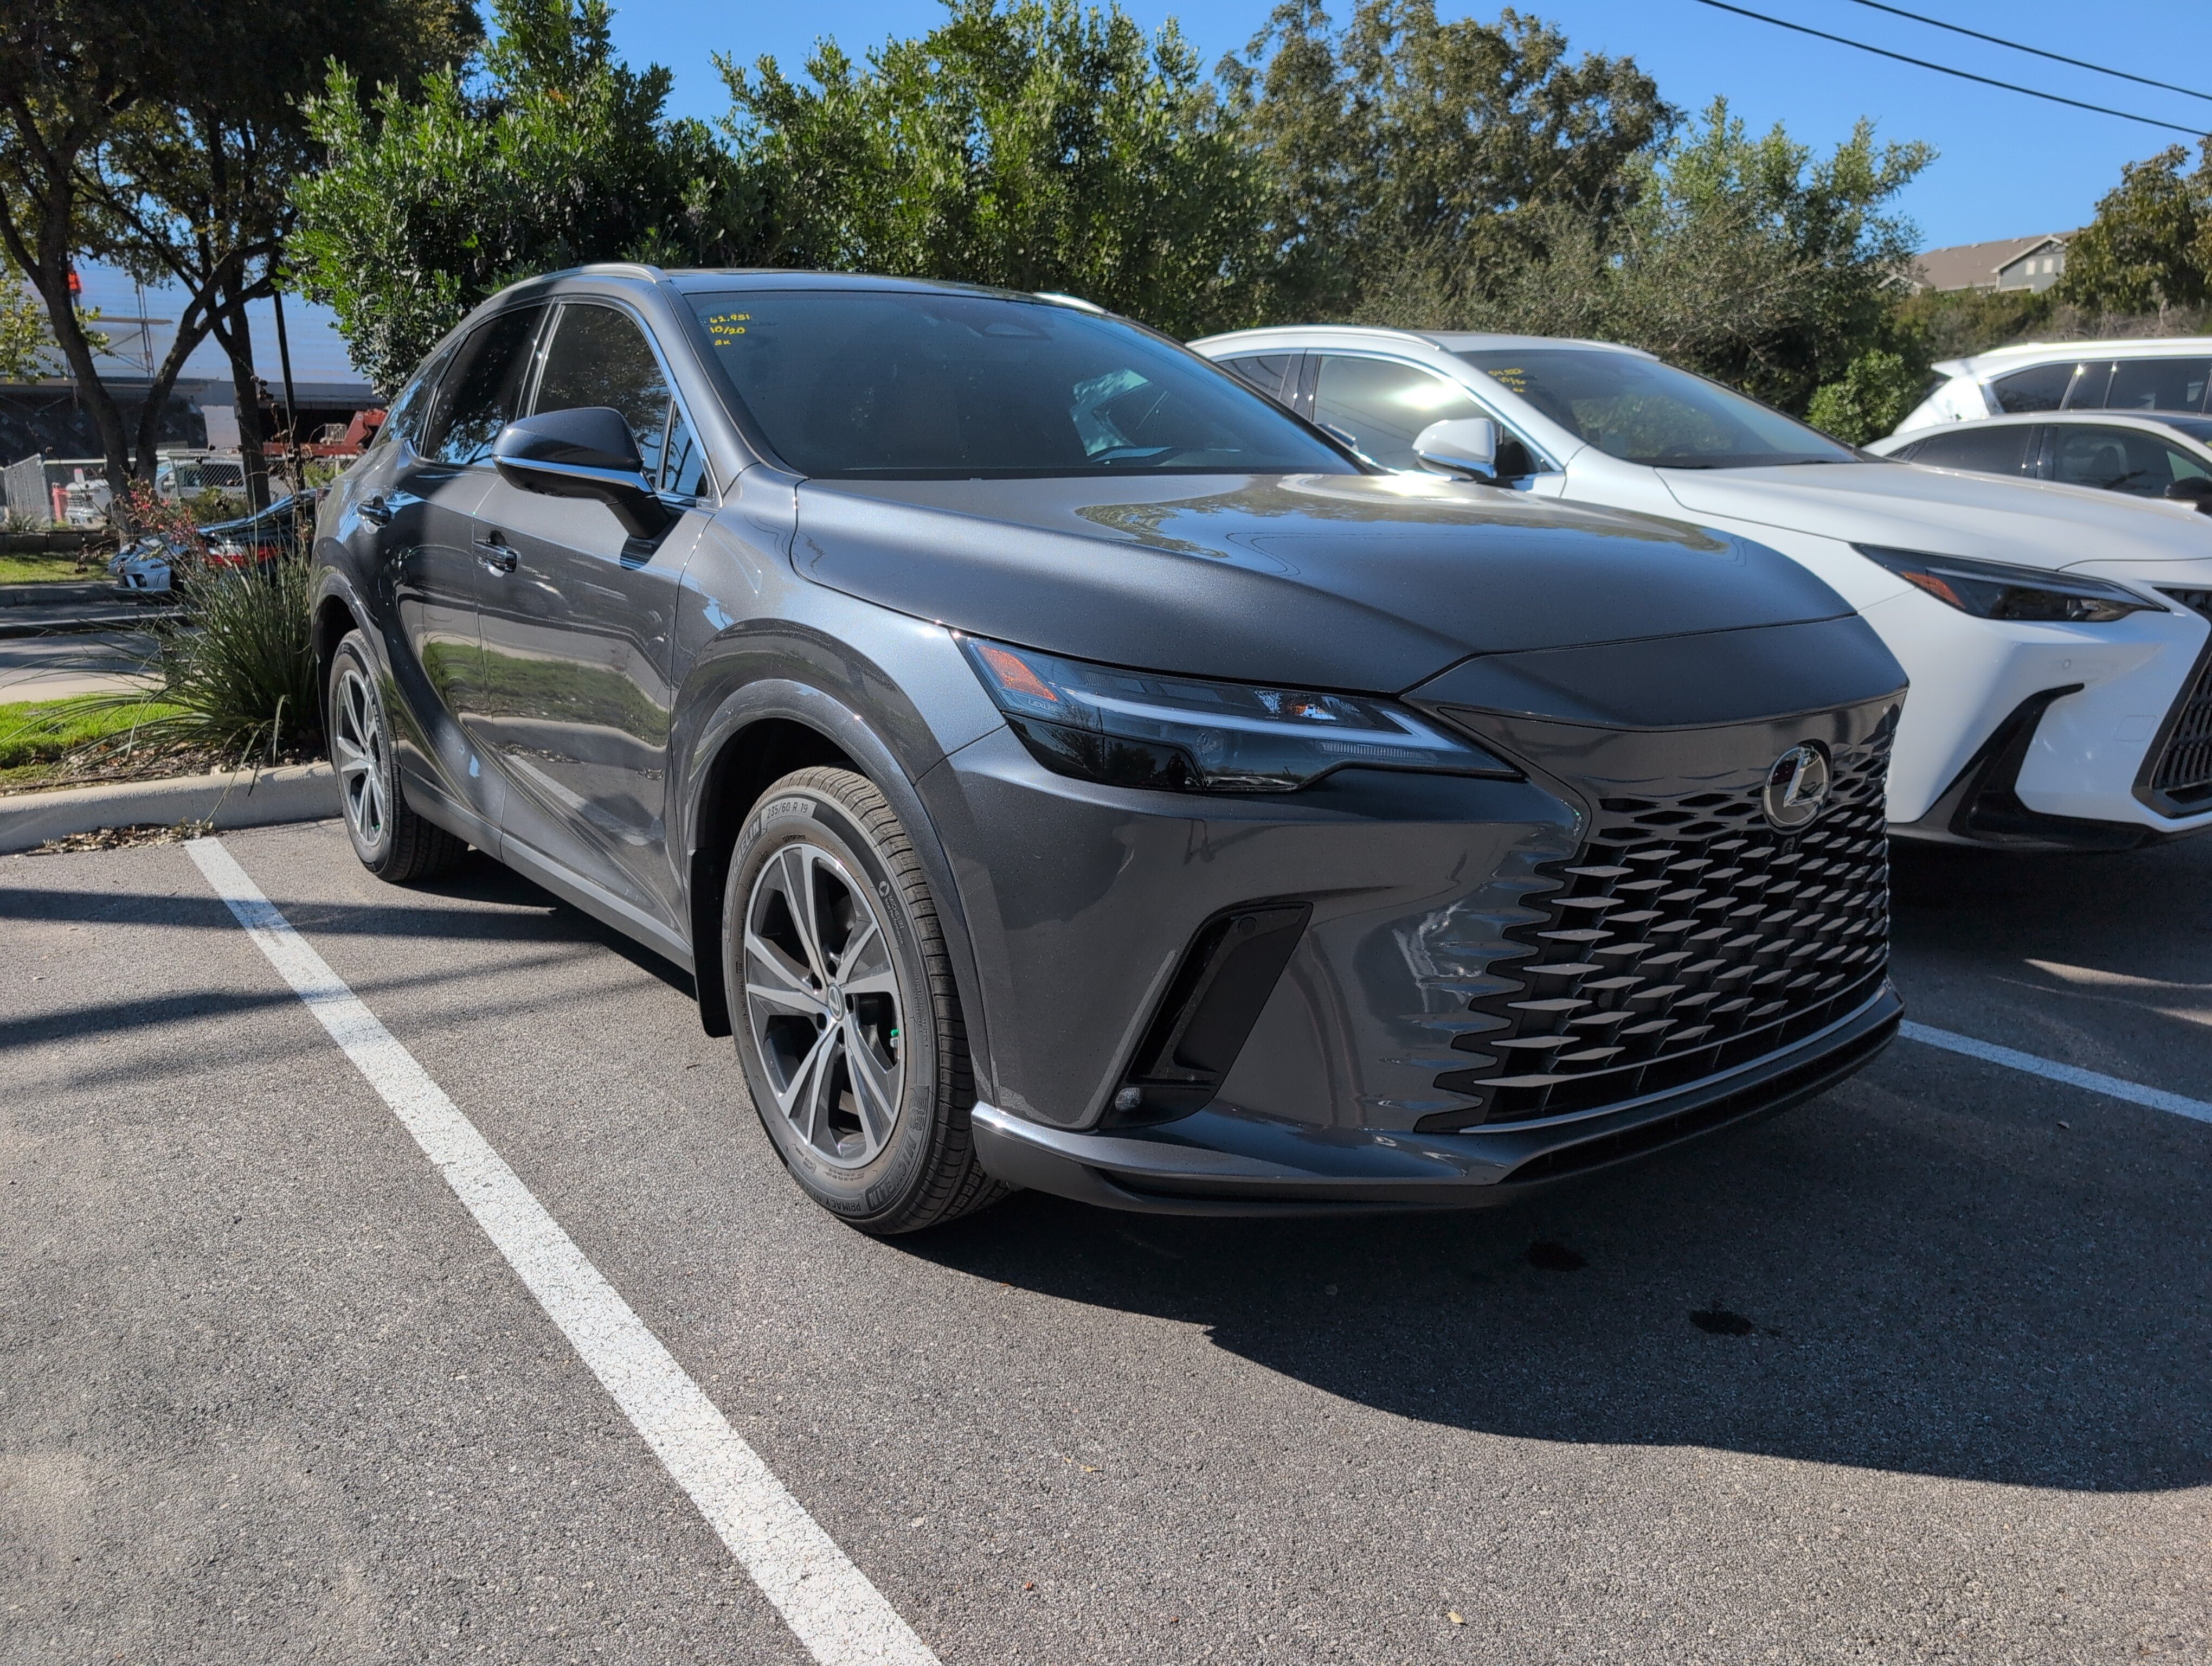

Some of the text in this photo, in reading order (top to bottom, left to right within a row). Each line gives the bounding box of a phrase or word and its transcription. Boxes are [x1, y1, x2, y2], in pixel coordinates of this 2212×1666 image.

[710, 325, 745, 335] 10/20
[767, 802, 808, 819] 235/60 R 19
[888, 895, 905, 929] MICHELIN
[826, 1197, 862, 1212] PRIMACY
